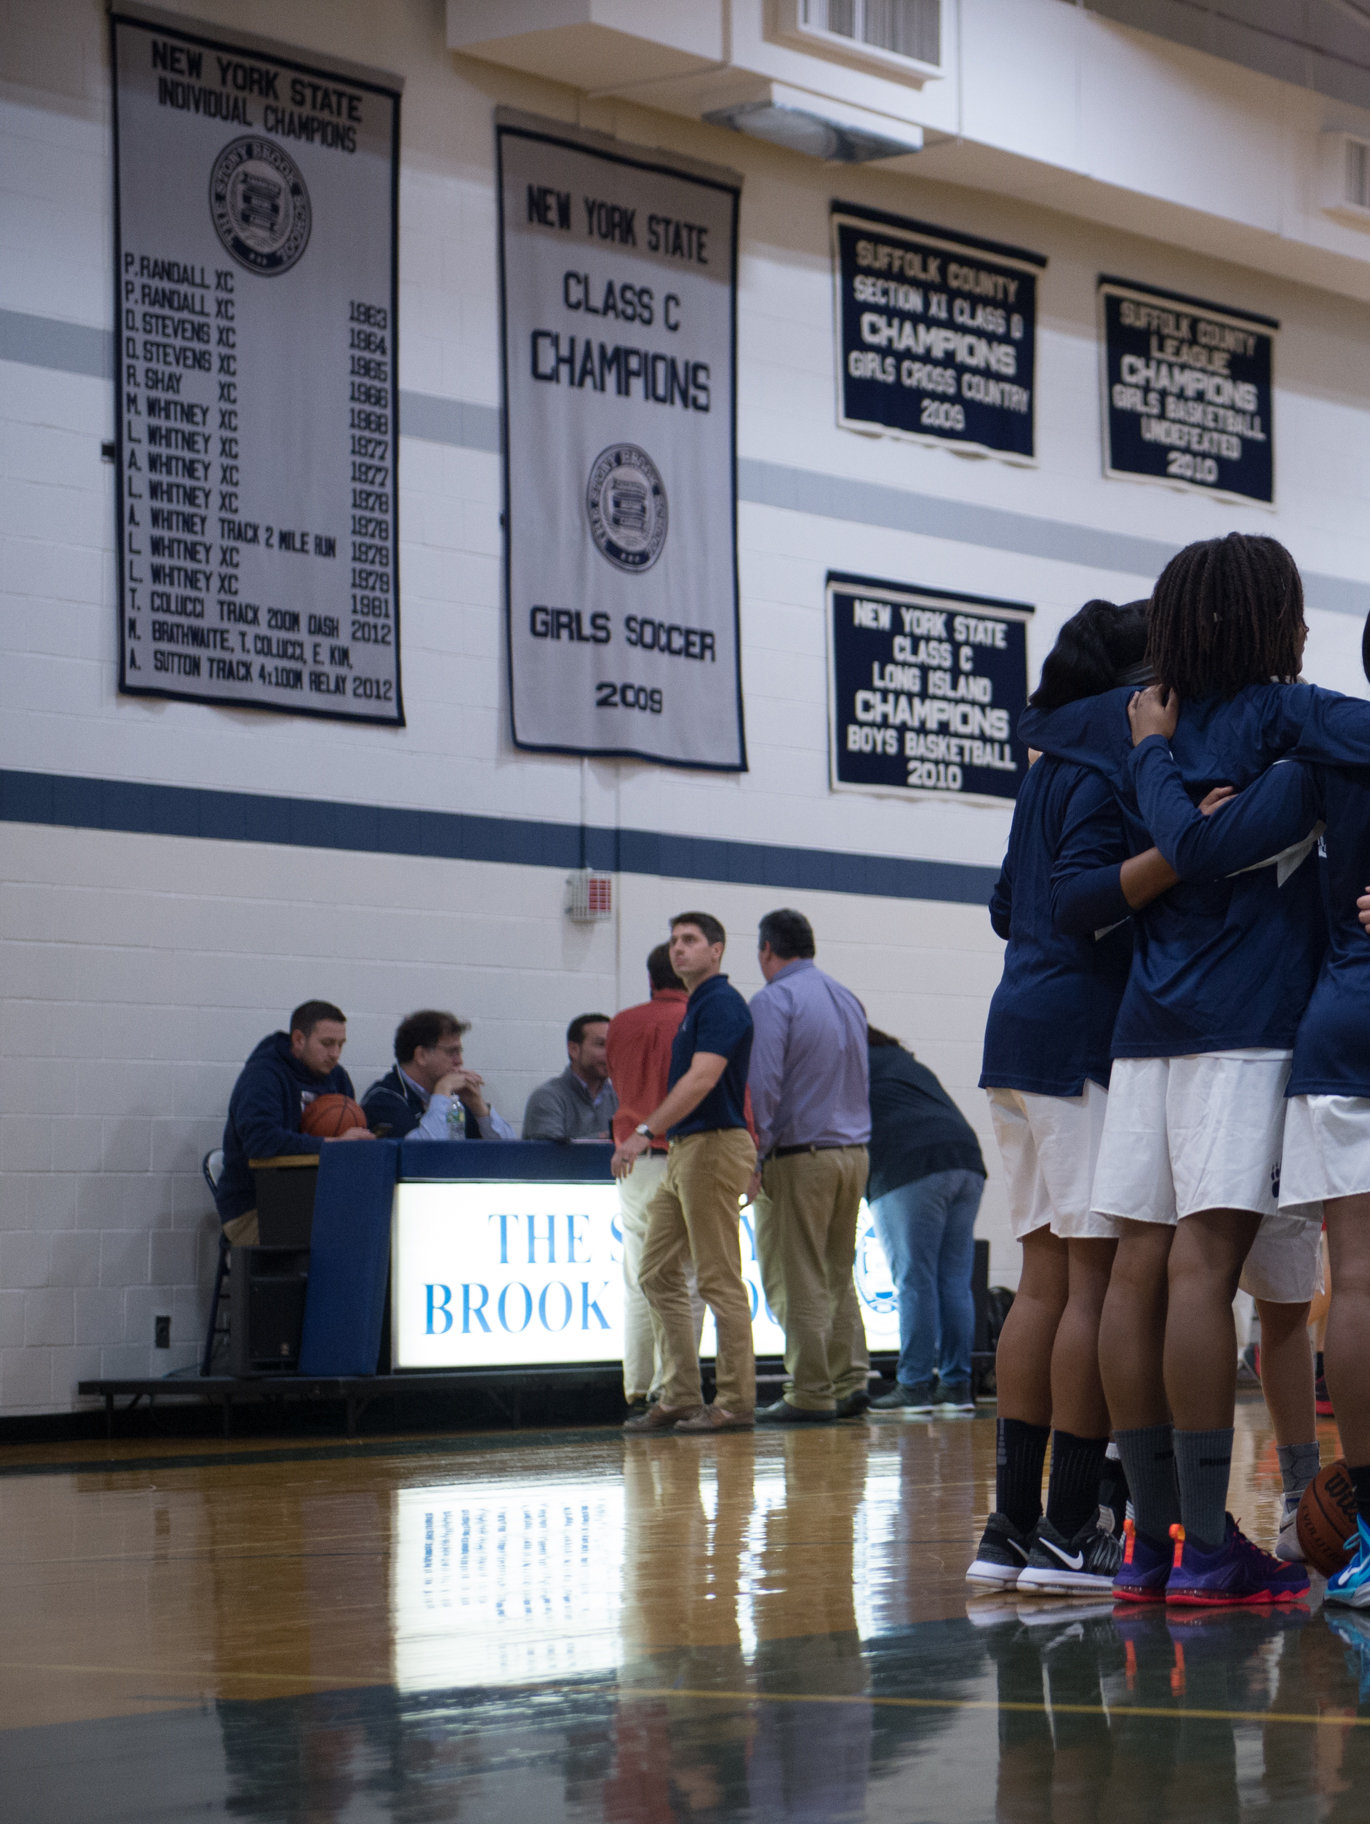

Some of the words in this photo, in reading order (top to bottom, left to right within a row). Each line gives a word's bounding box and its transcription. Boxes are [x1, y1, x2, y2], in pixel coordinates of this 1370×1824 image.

[152, 41, 203, 78] NEW
[217, 56, 279, 100] YORK
[291, 79, 363, 122] STATE
[158, 77, 253, 126] INDIVIDUAL
[264, 104, 357, 153] CHAMPIONS
[527, 184, 571, 231] NEW
[584, 196, 637, 248] YORK
[648, 213, 708, 265] STATE
[140, 256, 210, 289] RANDALL
[215, 269, 234, 293] XC
[349, 300, 387, 330] 1963
[855, 240, 942, 285] SUFFOLK
[947, 264, 1019, 304] COUNTY
[141, 284, 210, 317] RANDALL
[215, 297, 235, 321] XC
[350, 327, 387, 355] 1964
[563, 270, 654, 327] CLASS
[664, 293, 680, 332] C
[853, 274, 924, 314] SECTION
[928, 292, 949, 320] XI
[953, 297, 1007, 336] CLASS
[1119, 301, 1192, 341] SUFFOLK
[143, 312, 210, 344] STEVENS
[217, 324, 236, 348] XC
[143, 340, 212, 372] STEVENS
[218, 352, 236, 376] XC
[860, 311, 1017, 378] CHAMPIONS
[127, 364, 140, 388] R.
[145, 368, 182, 394] SHAY
[219, 380, 237, 404] XC
[531, 328, 710, 413] CHAMPIONS
[848, 350, 897, 384] GIRLS
[901, 359, 958, 396] CROSS
[961, 372, 1030, 414] COUNTRY
[1111, 383, 1161, 415] GIRLS
[1120, 353, 1258, 414] CHAMPIONS
[127, 391, 141, 416] M.
[147, 395, 209, 427] WHITNEY
[219, 408, 238, 432] XC
[351, 433, 388, 461] 1977
[128, 448, 141, 471] A.
[148, 451, 211, 482] WHITNEY
[220, 462, 239, 487] XC
[147, 423, 211, 454] WHITNEY
[220, 435, 238, 460] XC
[351, 460, 389, 488] 1977
[128, 475, 142, 499] L.
[149, 478, 212, 510] WHITNEY
[219, 490, 239, 514] XC
[128, 503, 140, 526] A.
[150, 506, 207, 536] WHITNEY
[219, 517, 260, 545] TRACK
[265, 526, 274, 548] 2
[279, 528, 309, 555] MILE
[314, 534, 336, 559] RUN
[130, 559, 143, 583] L.
[151, 562, 213, 592] WHITNEY
[218, 571, 239, 596] XC
[351, 594, 390, 618] 1981
[150, 534, 213, 565] WHITNEY
[220, 546, 240, 568] XC
[351, 567, 390, 593] 1979
[129, 588, 140, 611] T.
[151, 590, 204, 618] COLUCCI
[217, 599, 261, 627] TRACK
[267, 607, 300, 633] 200M
[308, 614, 339, 638] DASH
[351, 620, 391, 646] 2012
[529, 605, 611, 645] GIRLS
[625, 614, 716, 663] SOCCER
[853, 599, 891, 631] NEW
[900, 605, 949, 640] YORK
[953, 615, 1008, 650] STATE
[129, 647, 141, 670] A.
[153, 649, 201, 677] SUTTON
[208, 656, 253, 683] TRACK
[309, 670, 348, 695] RELAY
[353, 676, 393, 701] 2012
[239, 631, 250, 655] T.
[254, 634, 307, 665] COLUCCI,
[313, 643, 325, 666] E.
[893, 635, 952, 670] CLASS
[959, 645, 974, 673] C
[872, 660, 921, 693] LONG
[928, 669, 992, 704] ISLAND
[854, 689, 1010, 741] CHAMPIONS
[847, 724, 898, 756] BOYS
[904, 730, 1017, 772] BASKETBALL
[907, 760, 963, 791] 2010
[489, 1214, 591, 1264] THE
[424, 1281, 612, 1335] BROOK
